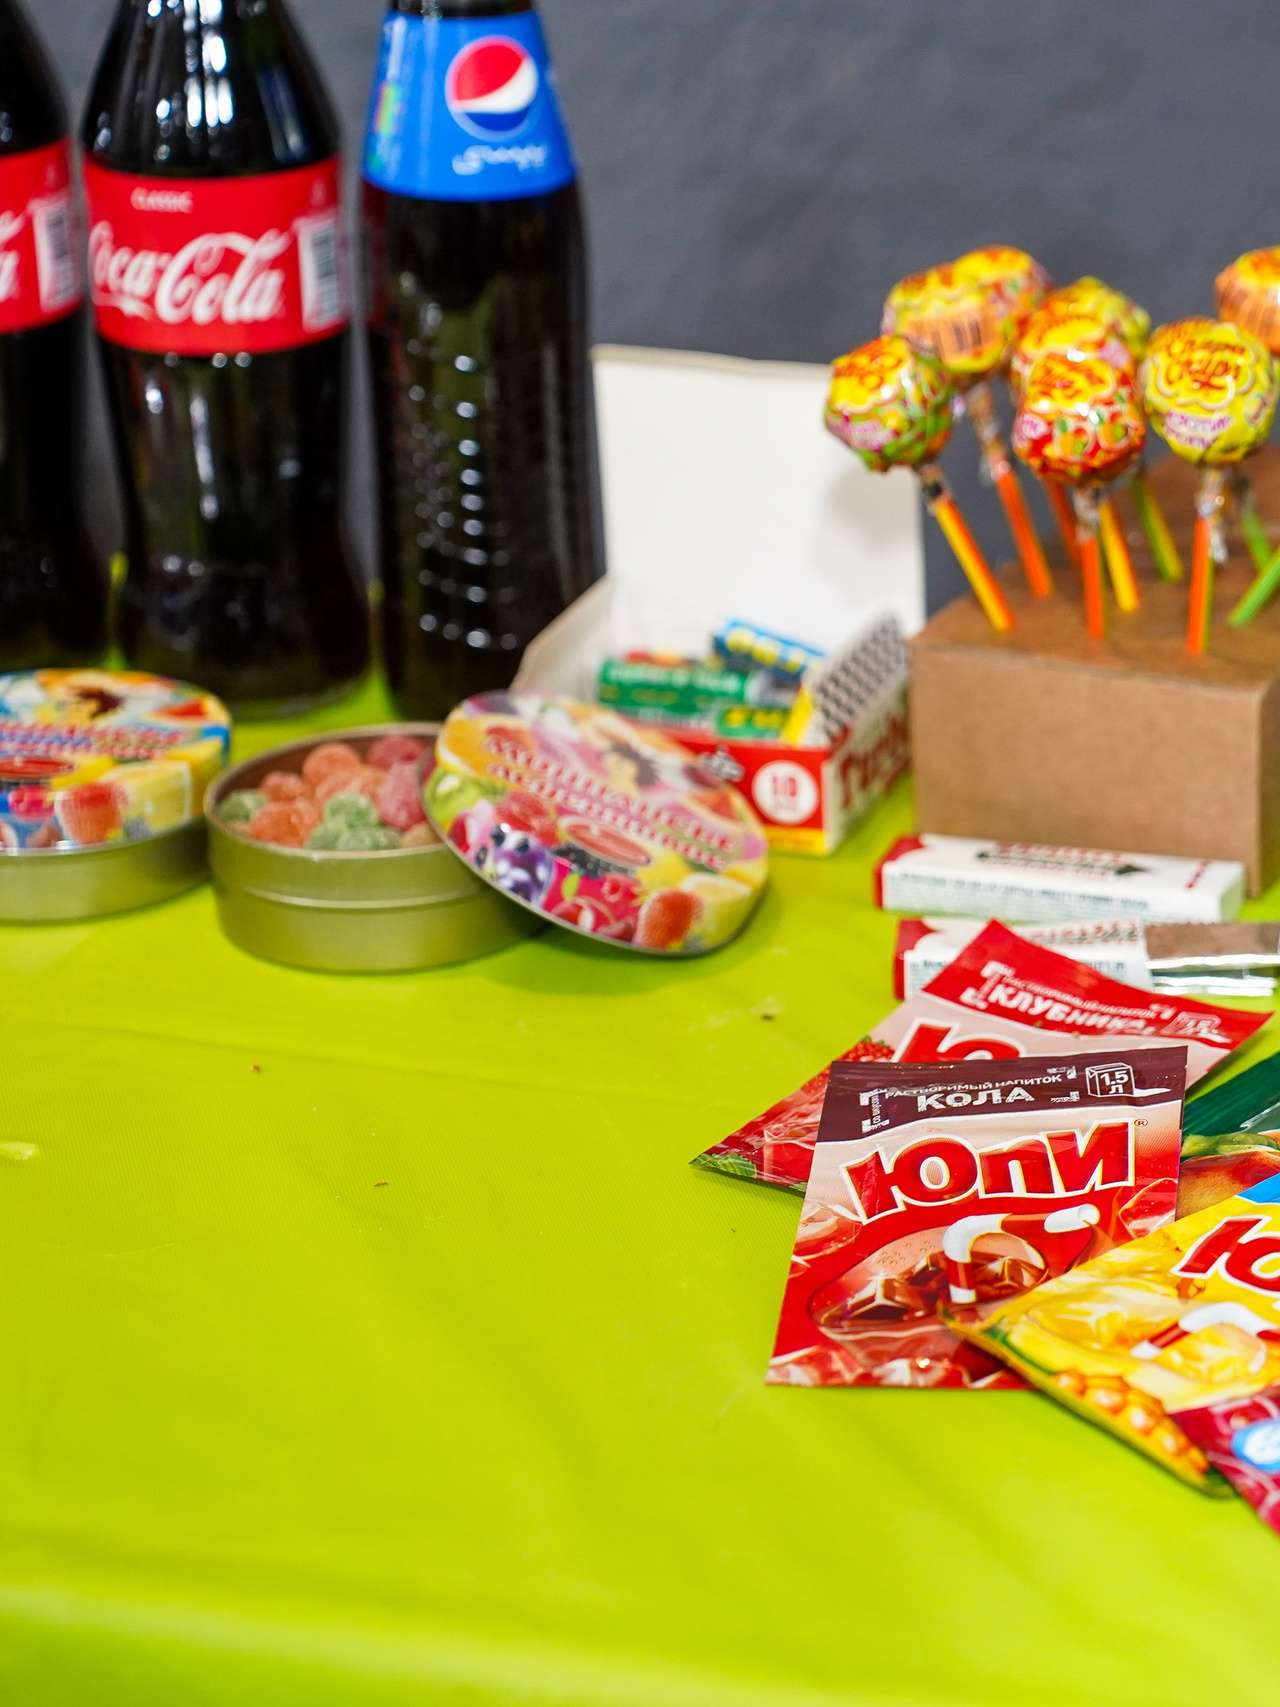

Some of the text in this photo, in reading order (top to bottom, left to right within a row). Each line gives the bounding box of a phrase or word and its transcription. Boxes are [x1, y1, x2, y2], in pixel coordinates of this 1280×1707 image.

[989, 984, 1148, 1031] КЛУБНИКА
[885, 1073, 1063, 1099] РАСТВОРИМЫЙ НАПИТОК
[1100, 1071, 1129, 1086] 1.5
[917, 1086, 1036, 1113] КОЛА
